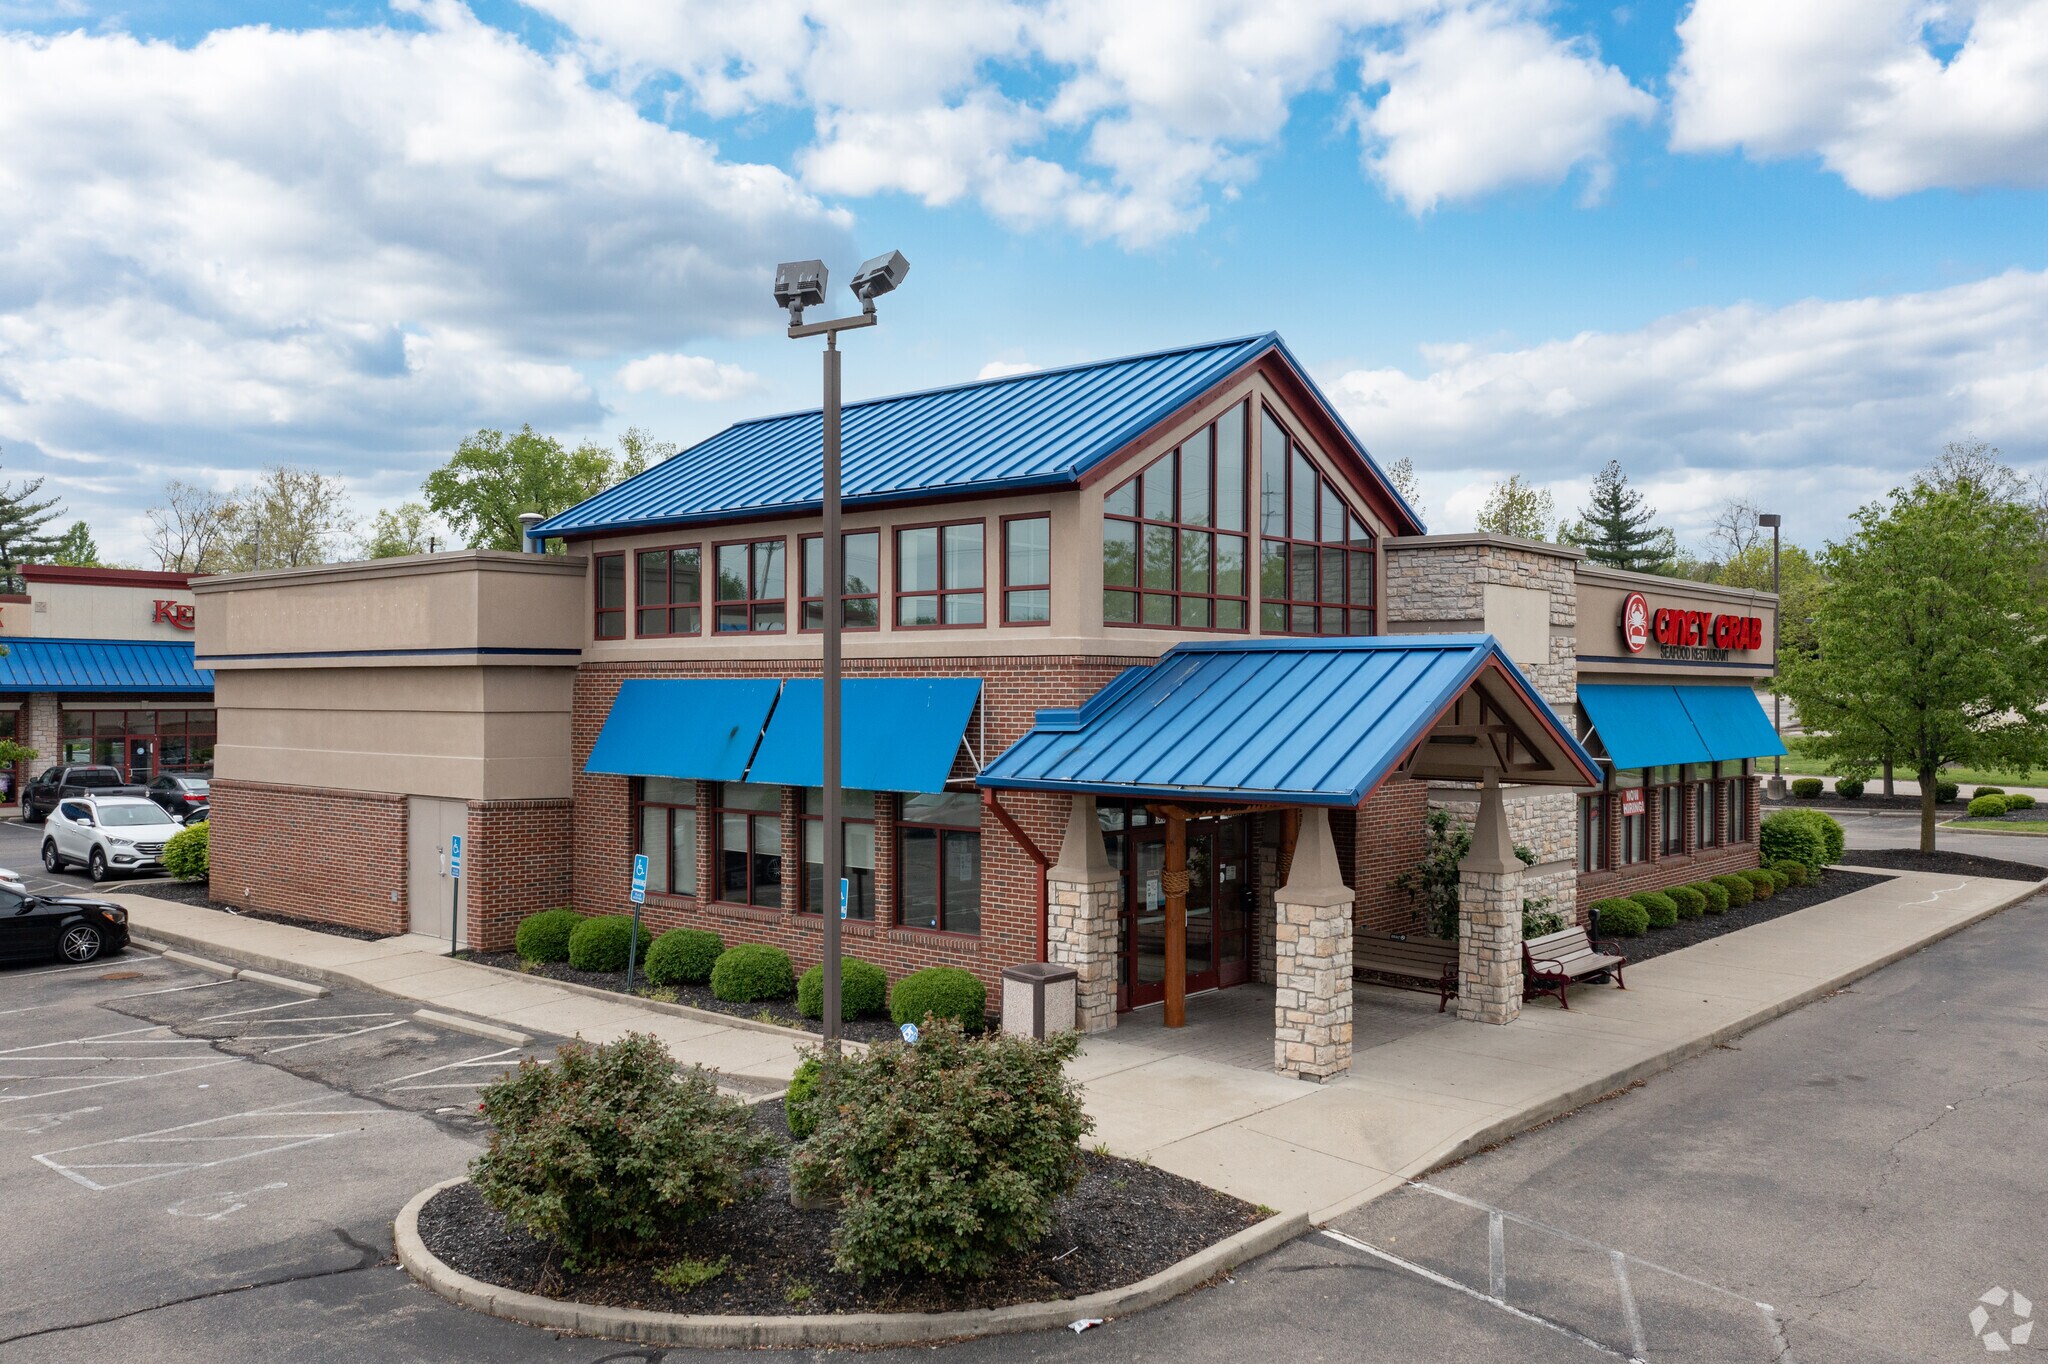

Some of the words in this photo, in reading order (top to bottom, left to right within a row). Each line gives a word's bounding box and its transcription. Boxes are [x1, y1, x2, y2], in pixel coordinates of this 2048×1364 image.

[152, 600, 195, 630] KE
[1713, 614, 1762, 650] CRAB
[1660, 645, 1690, 660] SEAFOOD
[1691, 647, 1729, 662] RESTAURANT
[1625, 789, 1640, 801] NOW
